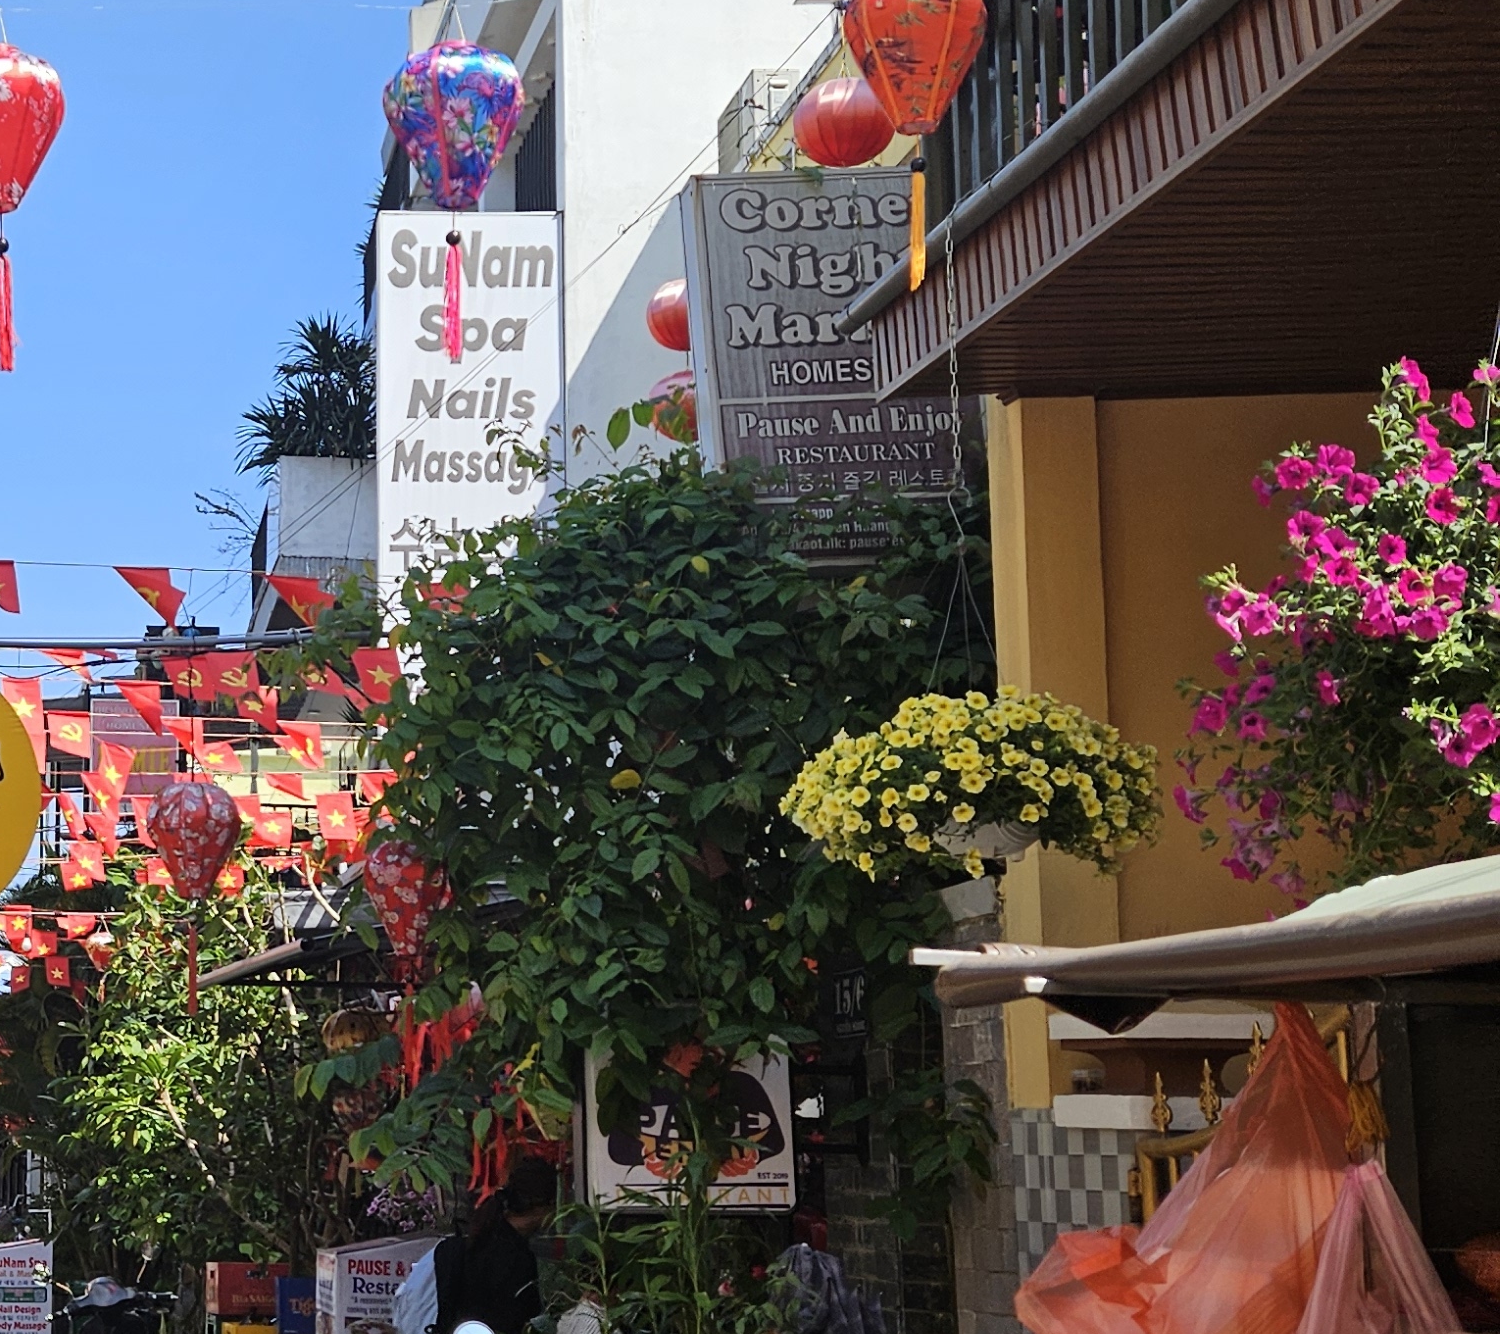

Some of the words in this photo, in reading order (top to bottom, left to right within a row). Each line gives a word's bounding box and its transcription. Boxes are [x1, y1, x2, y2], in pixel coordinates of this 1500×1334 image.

[720, 188, 913, 234] Corne
[387, 229, 554, 288] SuNam
[743, 242, 911, 296] Nigh
[415, 304, 528, 364] Spa
[725, 303, 873, 349] Mar
[770, 359, 874, 386] HOMES
[406, 377, 536, 419] Nails
[736, 412, 820, 438] Pause
[829, 406, 883, 435] And
[777, 442, 936, 465] RESTAURANT
[888, 468, 956, 487] 레스토
[757, 1172, 770, 1180] EST
[348, 1259, 391, 1276] PAUSE
[395, 1261, 405, 1277] &
[353, 1277, 400, 1295] Resta
[14, 1305, 41, 1316] Design
[14, 1321, 47, 1331] Massage
